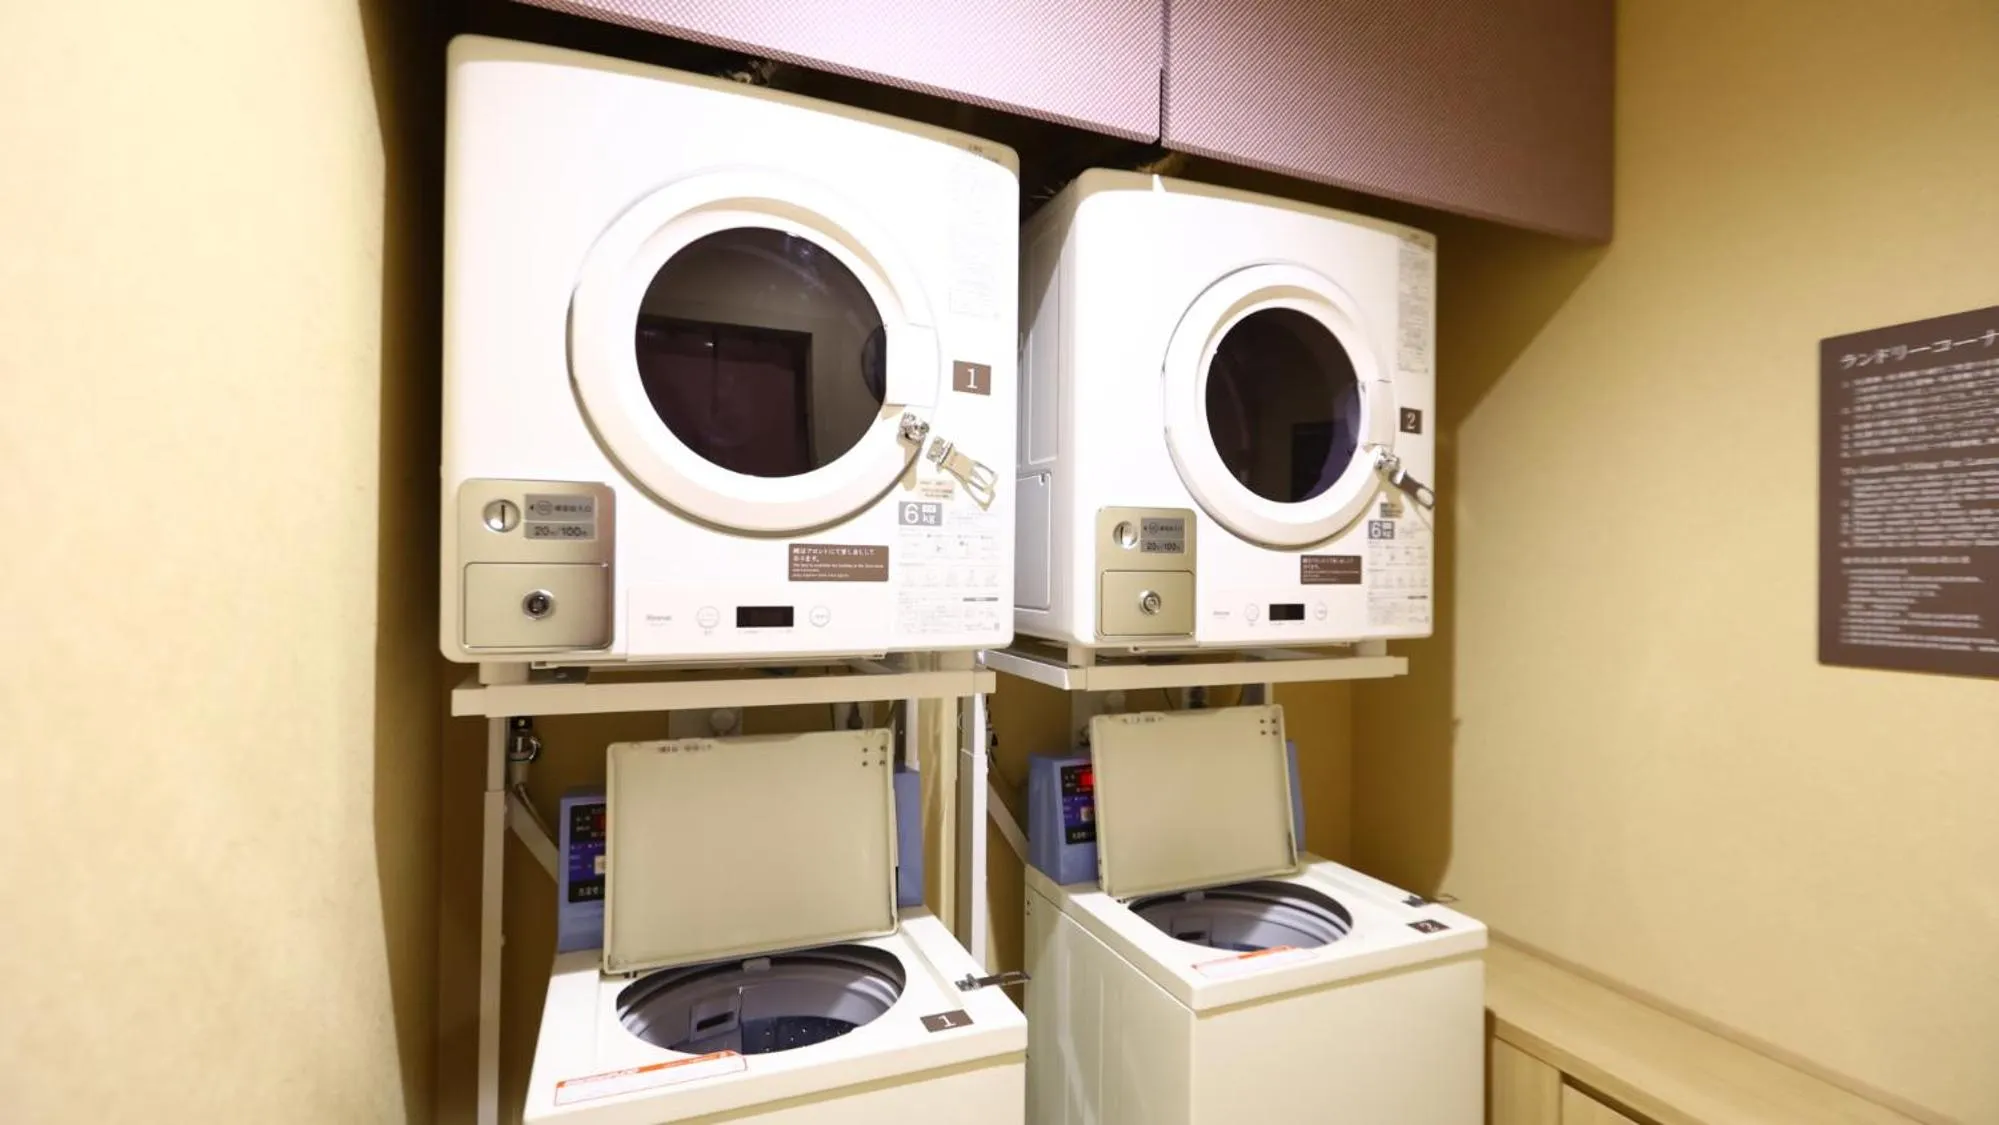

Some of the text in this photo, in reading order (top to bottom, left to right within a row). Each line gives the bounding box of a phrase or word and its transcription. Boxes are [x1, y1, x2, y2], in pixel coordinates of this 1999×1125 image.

[967, 368, 978, 389] 1
[1407, 411, 1416, 430] 2
[904, 503, 920, 524] 6
[1371, 522, 1381, 538] 6
[1419, 922, 1441, 932] 2
[938, 1015, 956, 1028] 1
